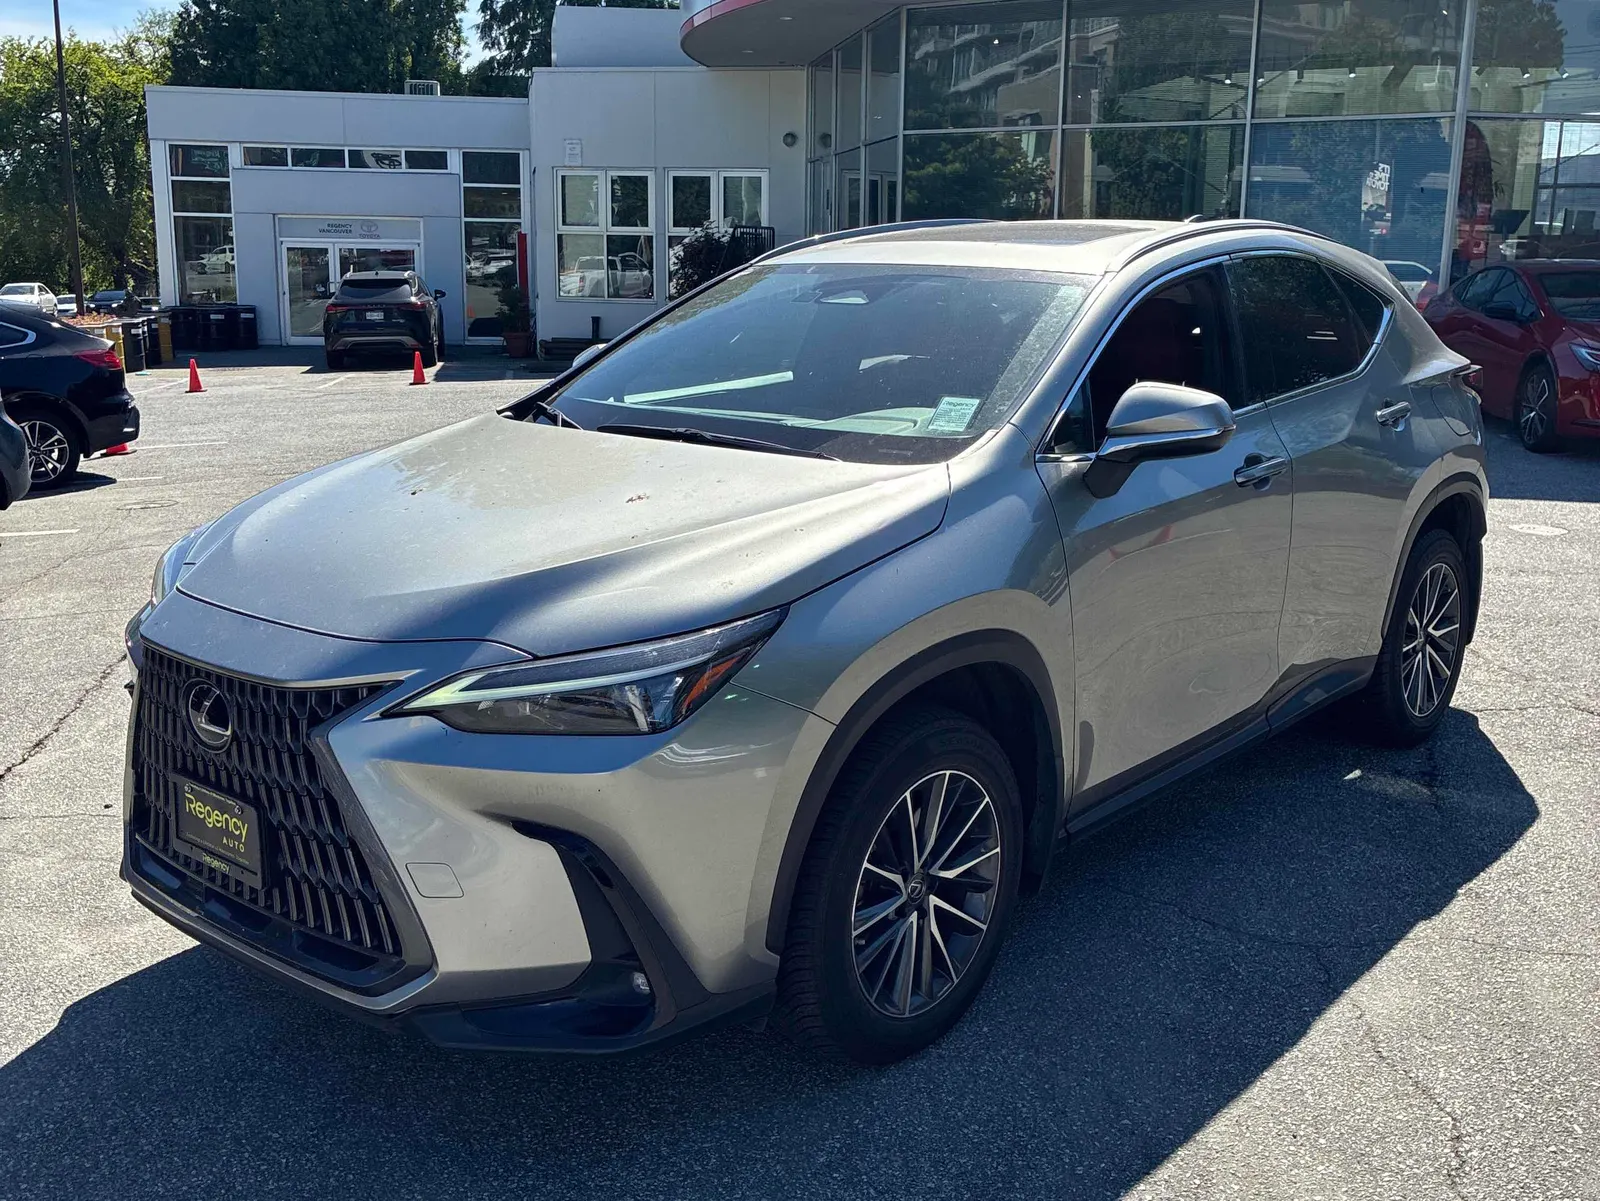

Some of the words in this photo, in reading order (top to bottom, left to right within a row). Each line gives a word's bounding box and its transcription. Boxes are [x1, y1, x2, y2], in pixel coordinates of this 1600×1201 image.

[184, 792, 248, 843] Regency
[222, 836, 245, 852] AUTO
[202, 852, 230, 874] Regency
